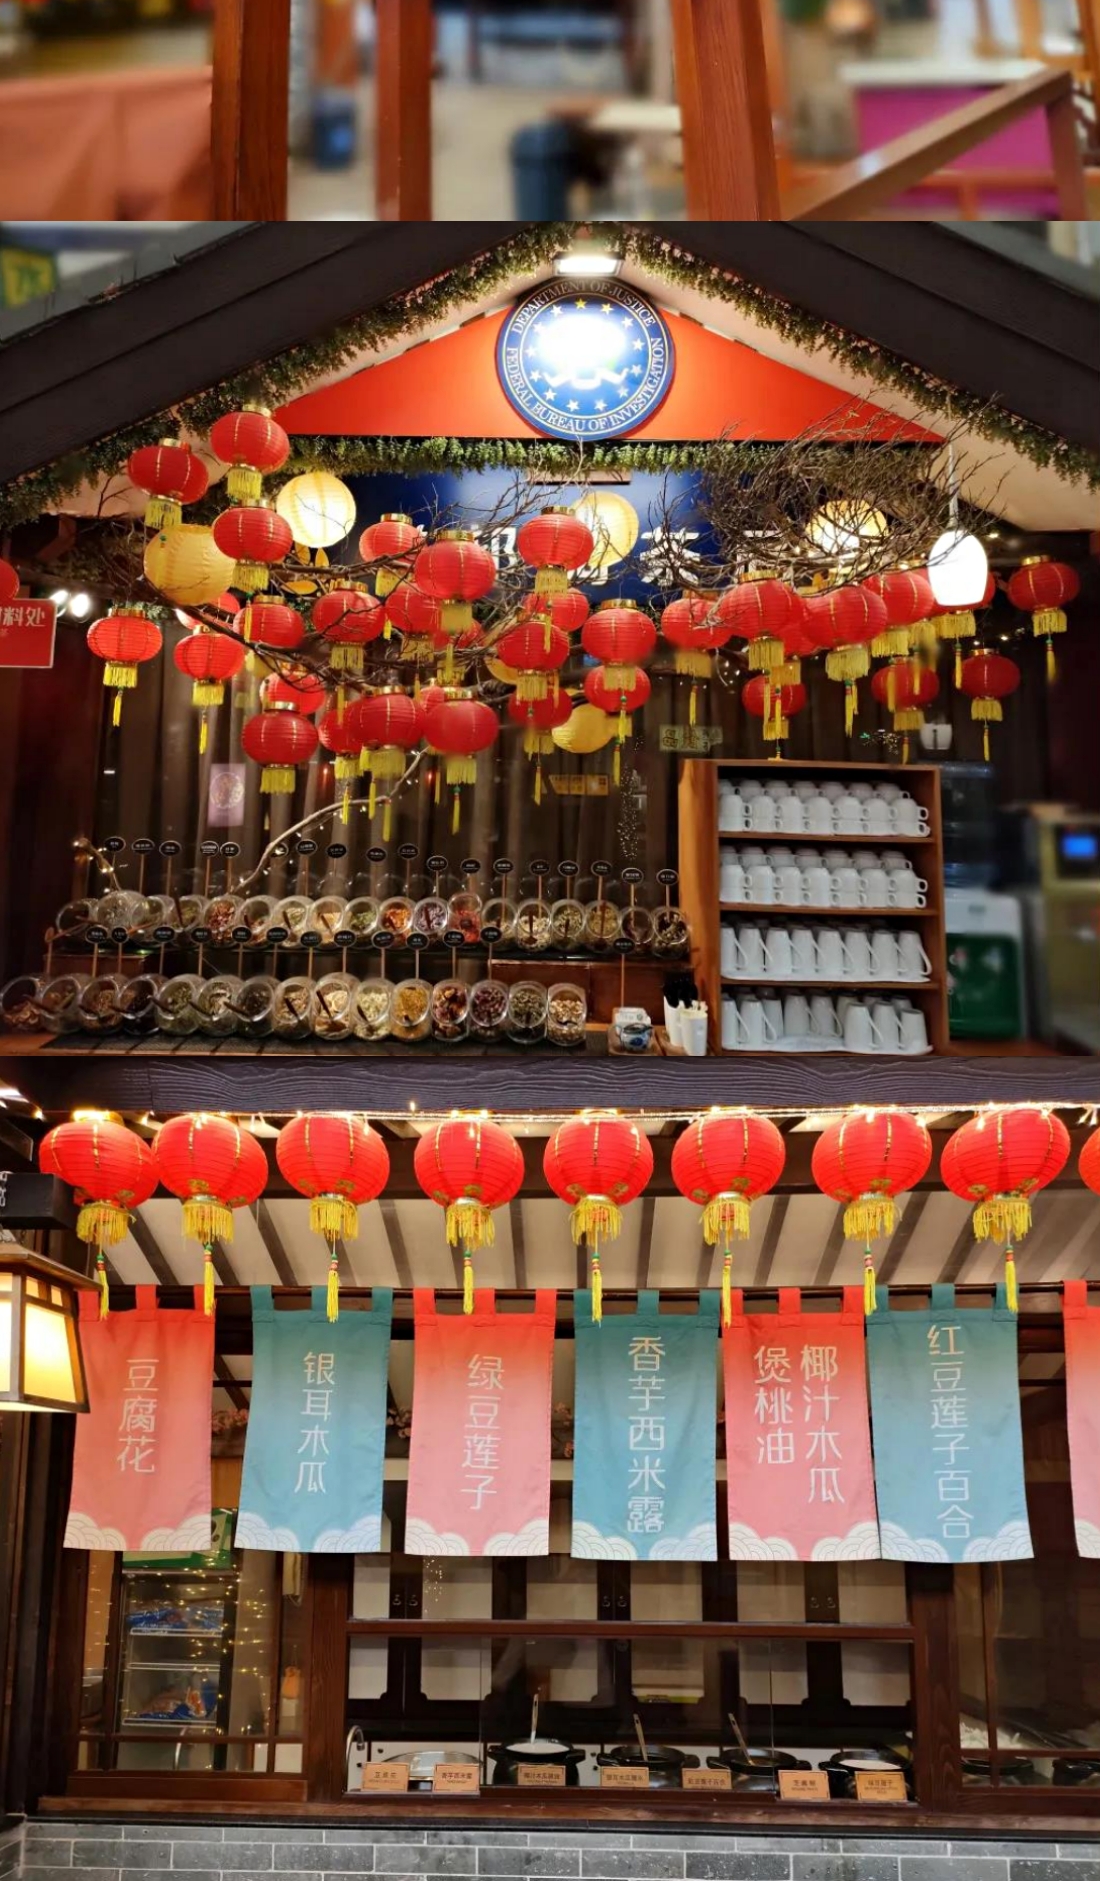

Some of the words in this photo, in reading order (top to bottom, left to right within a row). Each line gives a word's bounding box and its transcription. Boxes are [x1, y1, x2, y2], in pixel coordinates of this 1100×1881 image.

[511, 280, 586, 336] DEPARTMENT
[589, 280, 610, 294] OF
[609, 282, 656, 328] JUSTICE
[506, 347, 532, 407] FEDERAL
[532, 401, 586, 432] BUREAU
[588, 419, 609, 431] OF
[606, 337, 665, 429] INVESTIGATION
[0, 606, 46, 627] 料处
[116, 1358, 160, 1474] 豆腐花
[293, 1351, 336, 1495] 银耳木瓜
[460, 1353, 505, 1510] 绿豆莲子
[627, 1336, 666, 1534] 香芋西米露
[752, 1344, 795, 1466] 煲桃油
[799, 1344, 846, 1505] 椰汁木瓜
[926, 1324, 975, 1539] 红豆莲子百合
